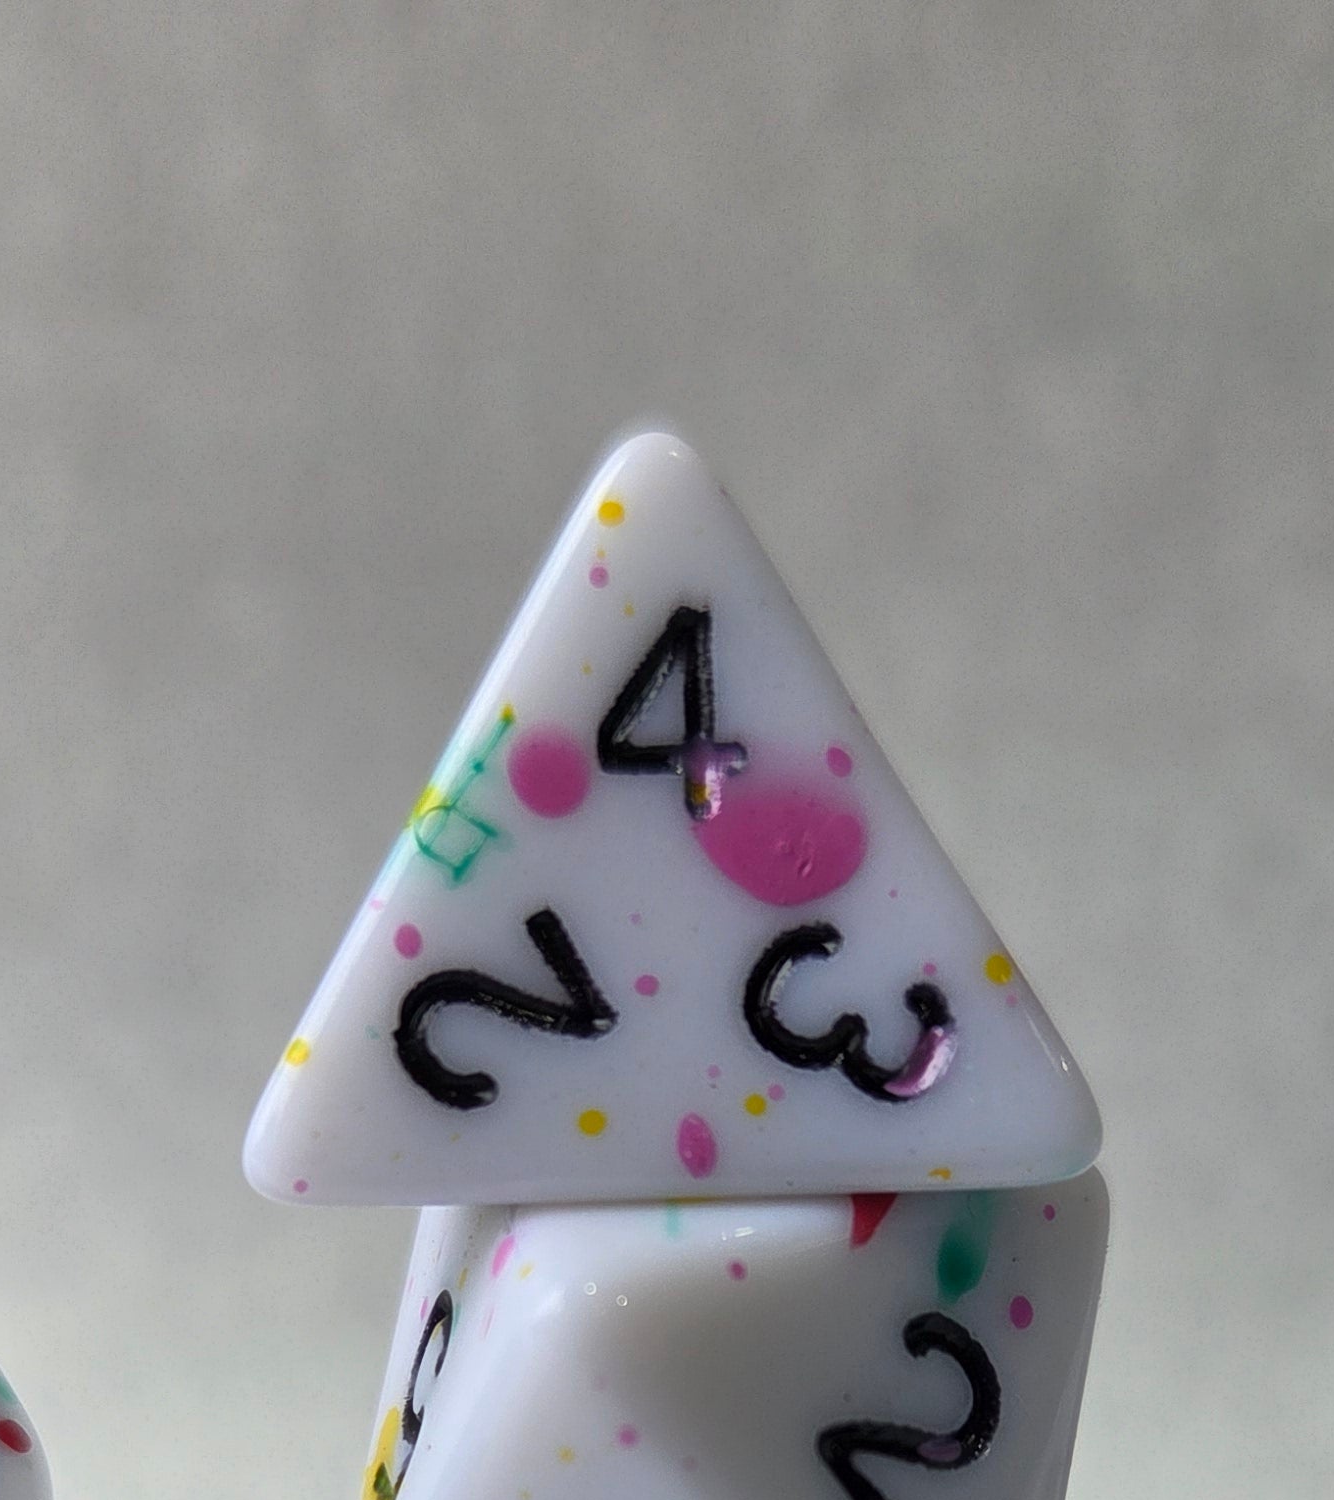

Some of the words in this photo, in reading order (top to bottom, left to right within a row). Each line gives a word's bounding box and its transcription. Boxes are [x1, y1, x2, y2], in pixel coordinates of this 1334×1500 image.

[597, 605, 748, 821] 4
[396, 910, 617, 1108] 2
[745, 924, 957, 1103] 3
